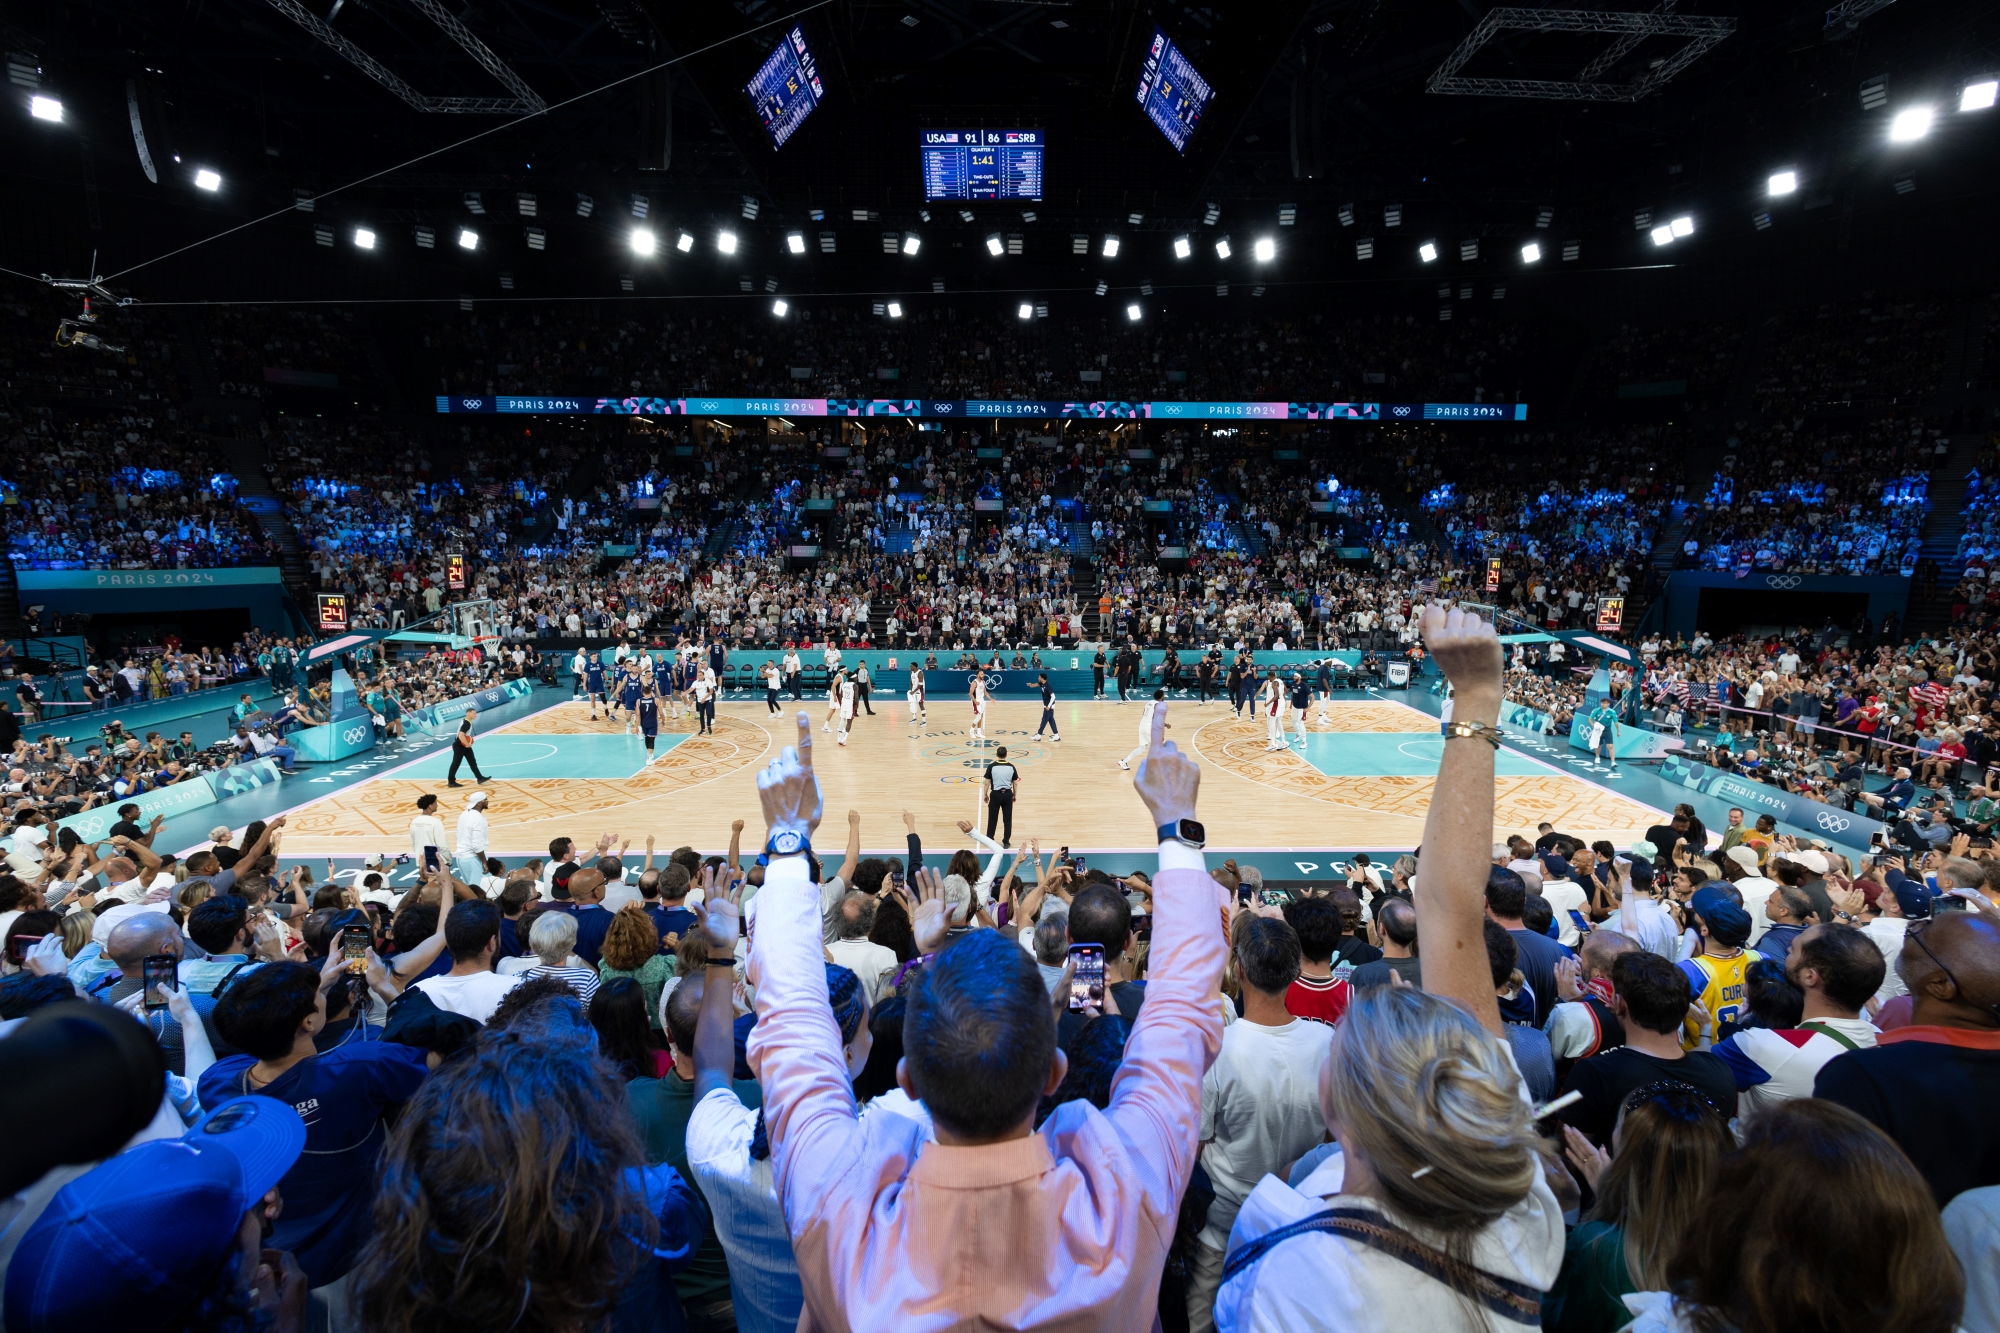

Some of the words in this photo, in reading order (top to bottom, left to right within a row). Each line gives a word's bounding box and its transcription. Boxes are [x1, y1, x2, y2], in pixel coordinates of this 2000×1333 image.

[926, 134, 946, 143] USA
[965, 134, 977, 143] 91
[988, 134, 1000, 143] 86
[1018, 134, 1036, 143] SRB
[972, 155, 994, 165] 1:41
[548, 401, 579, 409] 2024
[784, 403, 814, 411] 2024
[1016, 405, 1046, 413] 2024
[164, 573, 213, 584] 2024
[449, 567, 462, 581] 24
[1488, 571, 1499, 584] 24
[322, 607, 343, 621] 24
[1600, 610, 1620, 623] 24
[175, 788, 206, 803] 2024
[1758, 795, 1787, 811] 2024
[290, 1098, 320, 1115] ga
